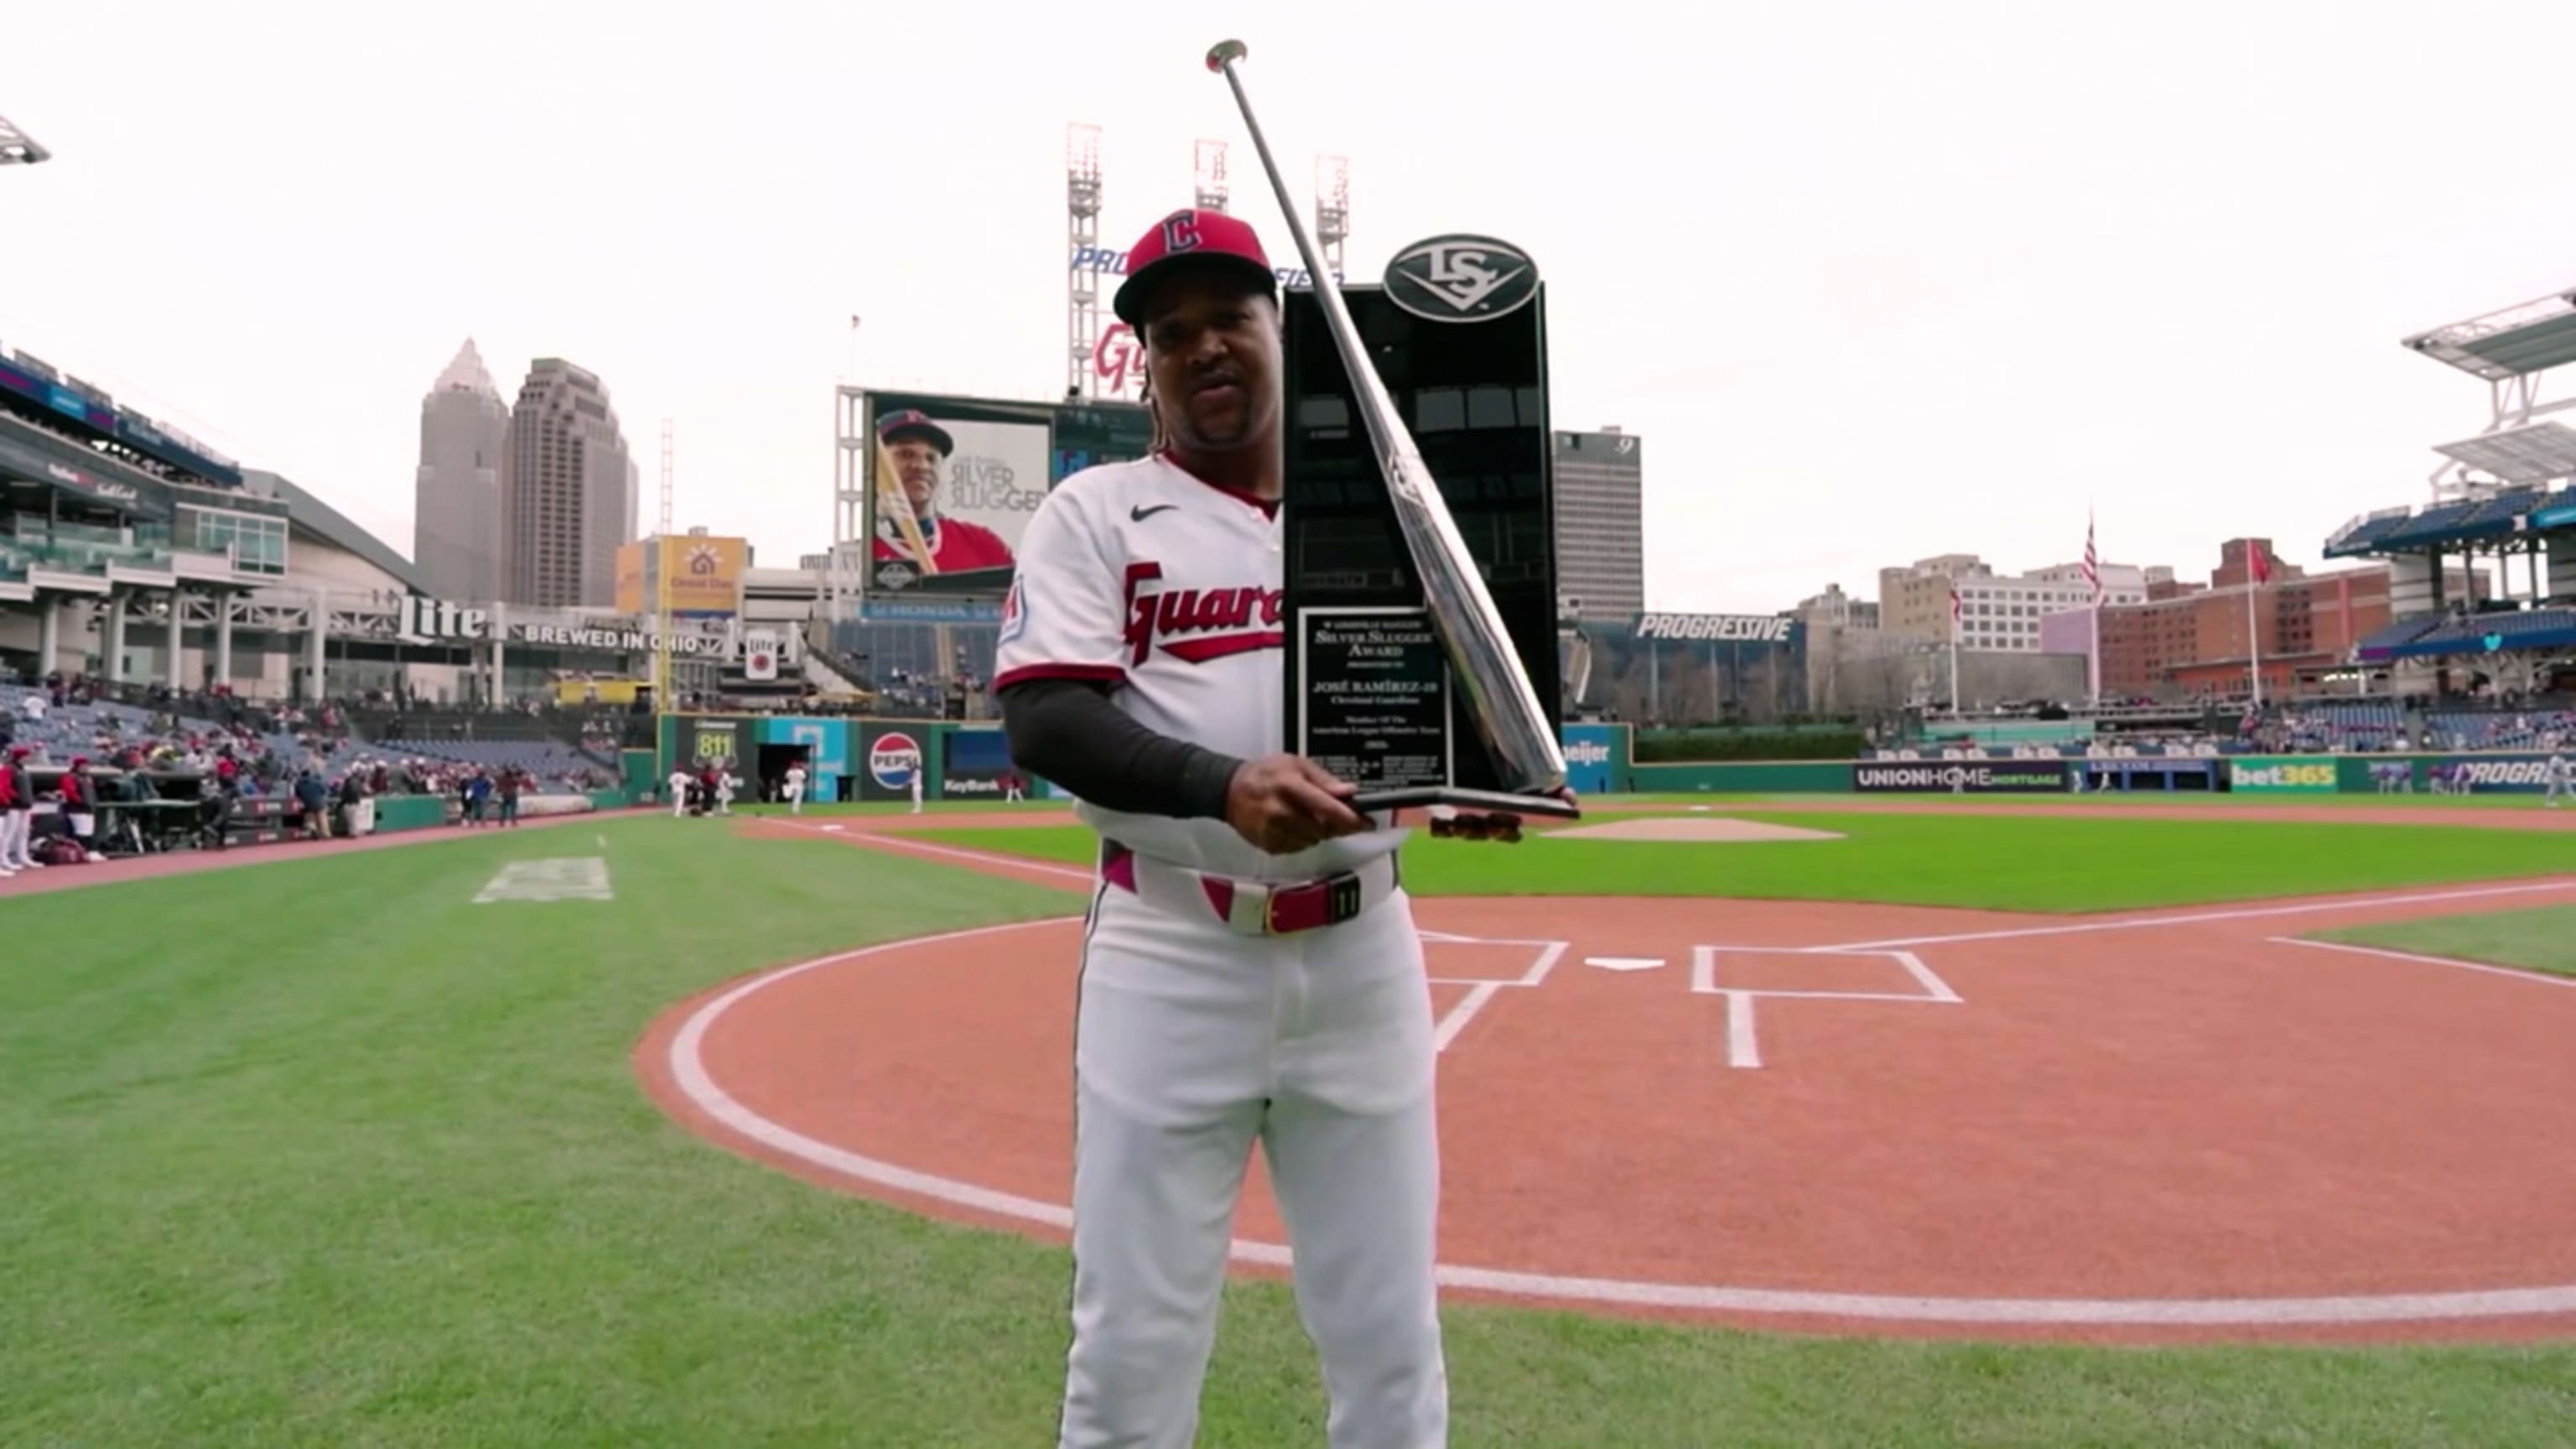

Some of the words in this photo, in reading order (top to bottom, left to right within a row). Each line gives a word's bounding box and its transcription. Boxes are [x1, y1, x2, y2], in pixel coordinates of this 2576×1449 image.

[396, 596, 486, 646] Lite
[1637, 615, 1793, 641] PROGRESSIVE
[525, 626, 618, 647] BREWED
[623, 633, 645, 649] IN
[649, 634, 698, 652] OHIO
[699, 734, 730, 757] 811
[874, 755, 920, 768] PEPSI
[944, 779, 1000, 792] KeyBank
[2231, 763, 2336, 786] bet365
